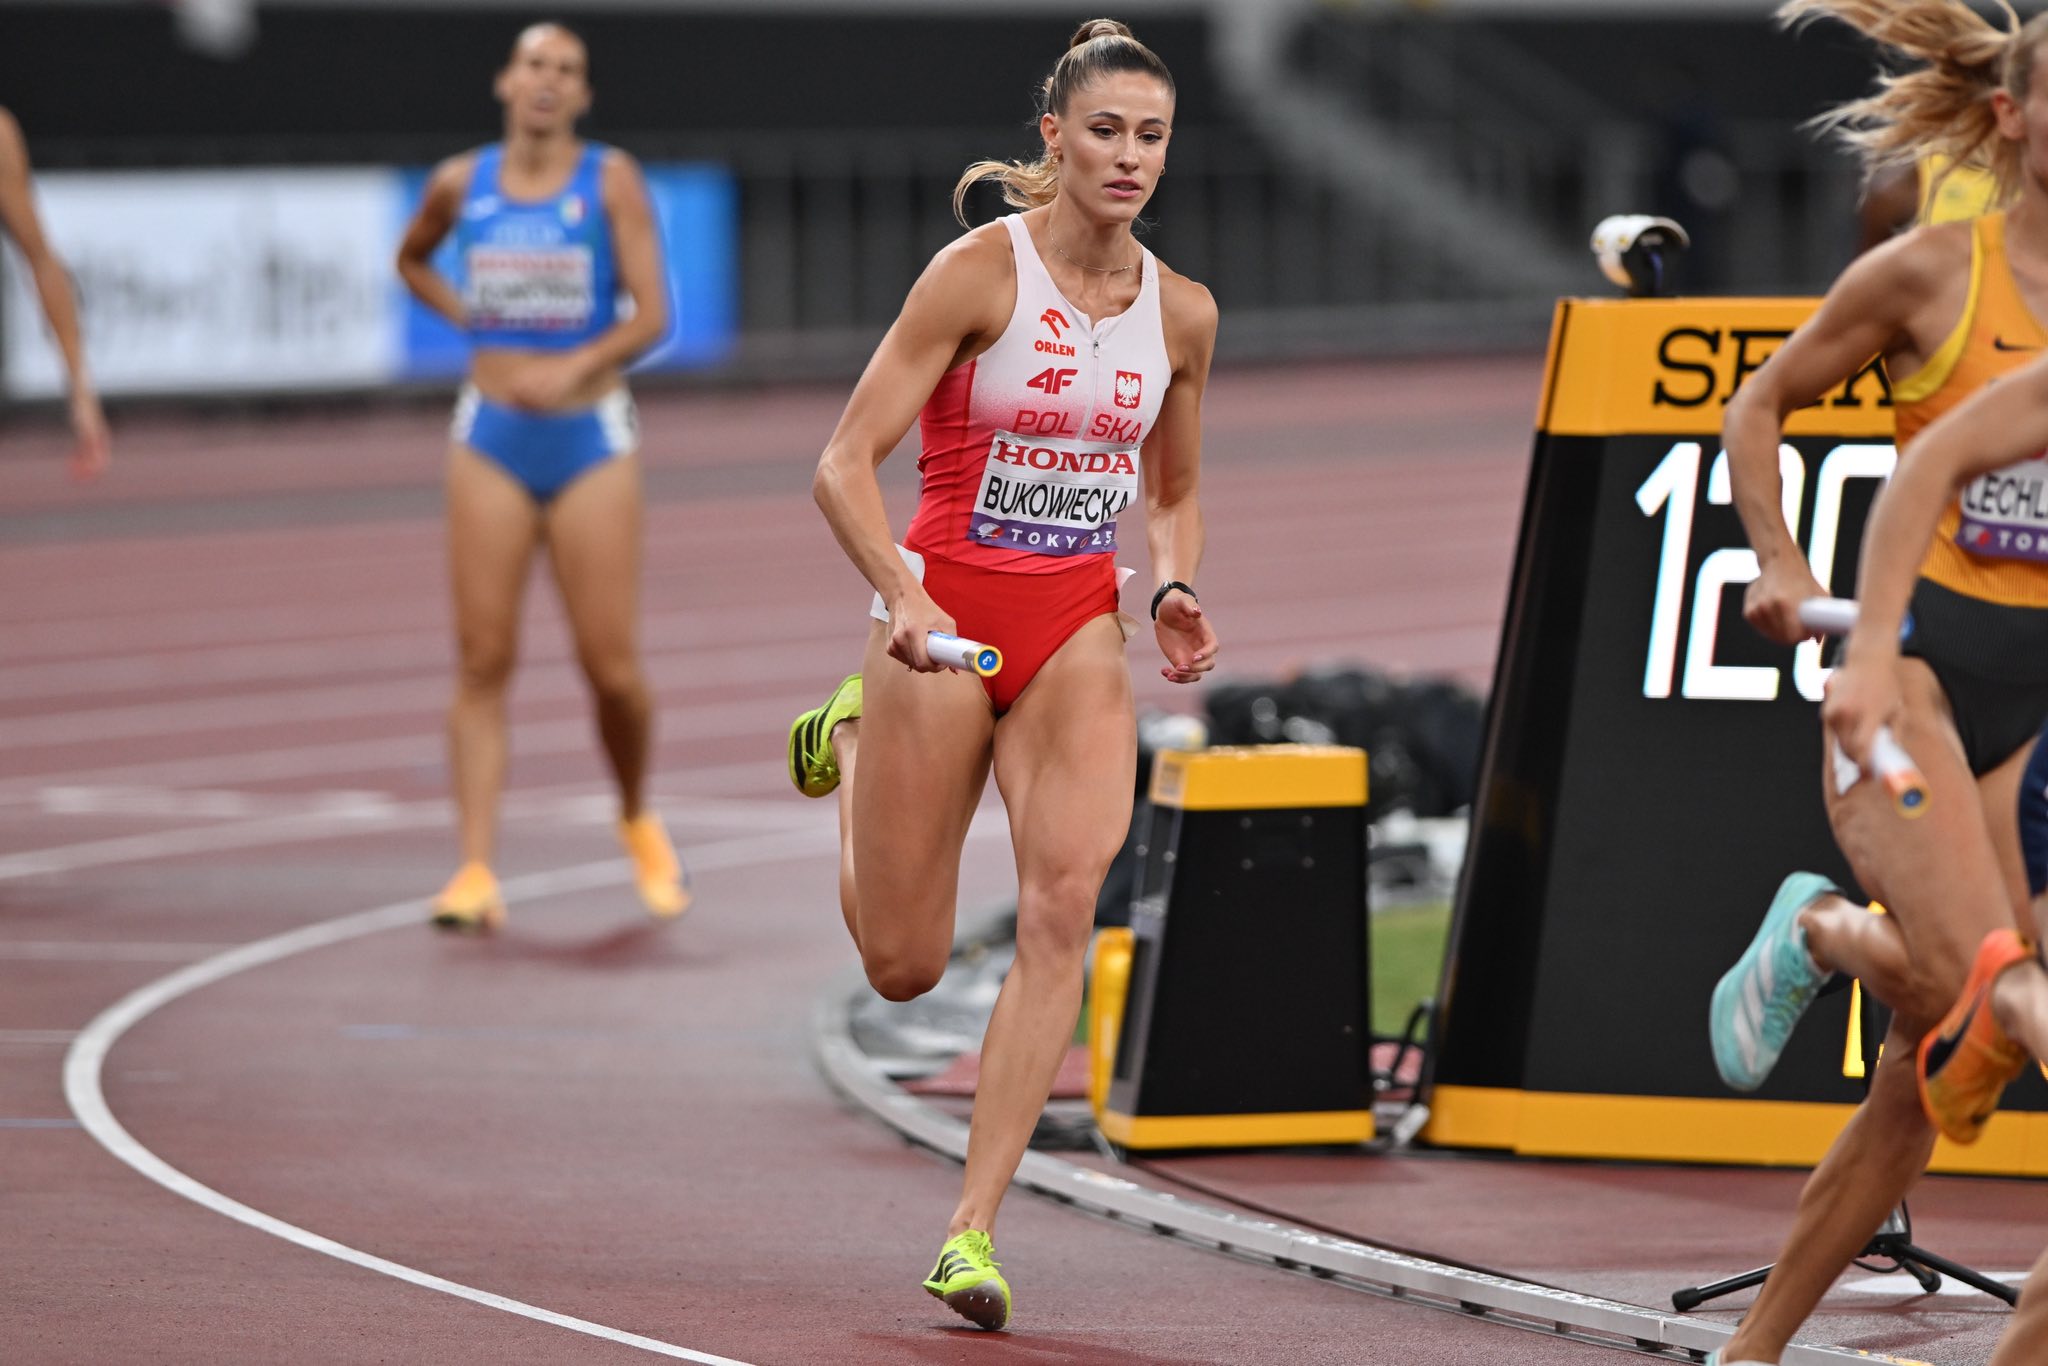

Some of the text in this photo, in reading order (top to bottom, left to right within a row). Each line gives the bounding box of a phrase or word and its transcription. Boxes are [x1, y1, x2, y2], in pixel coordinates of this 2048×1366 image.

[1034, 339, 1076, 357] ORLEN
[1026, 367, 1079, 395] 4F
[993, 440, 1136, 475] HONDA
[983, 475, 1129, 523] BUKOWIECKA
